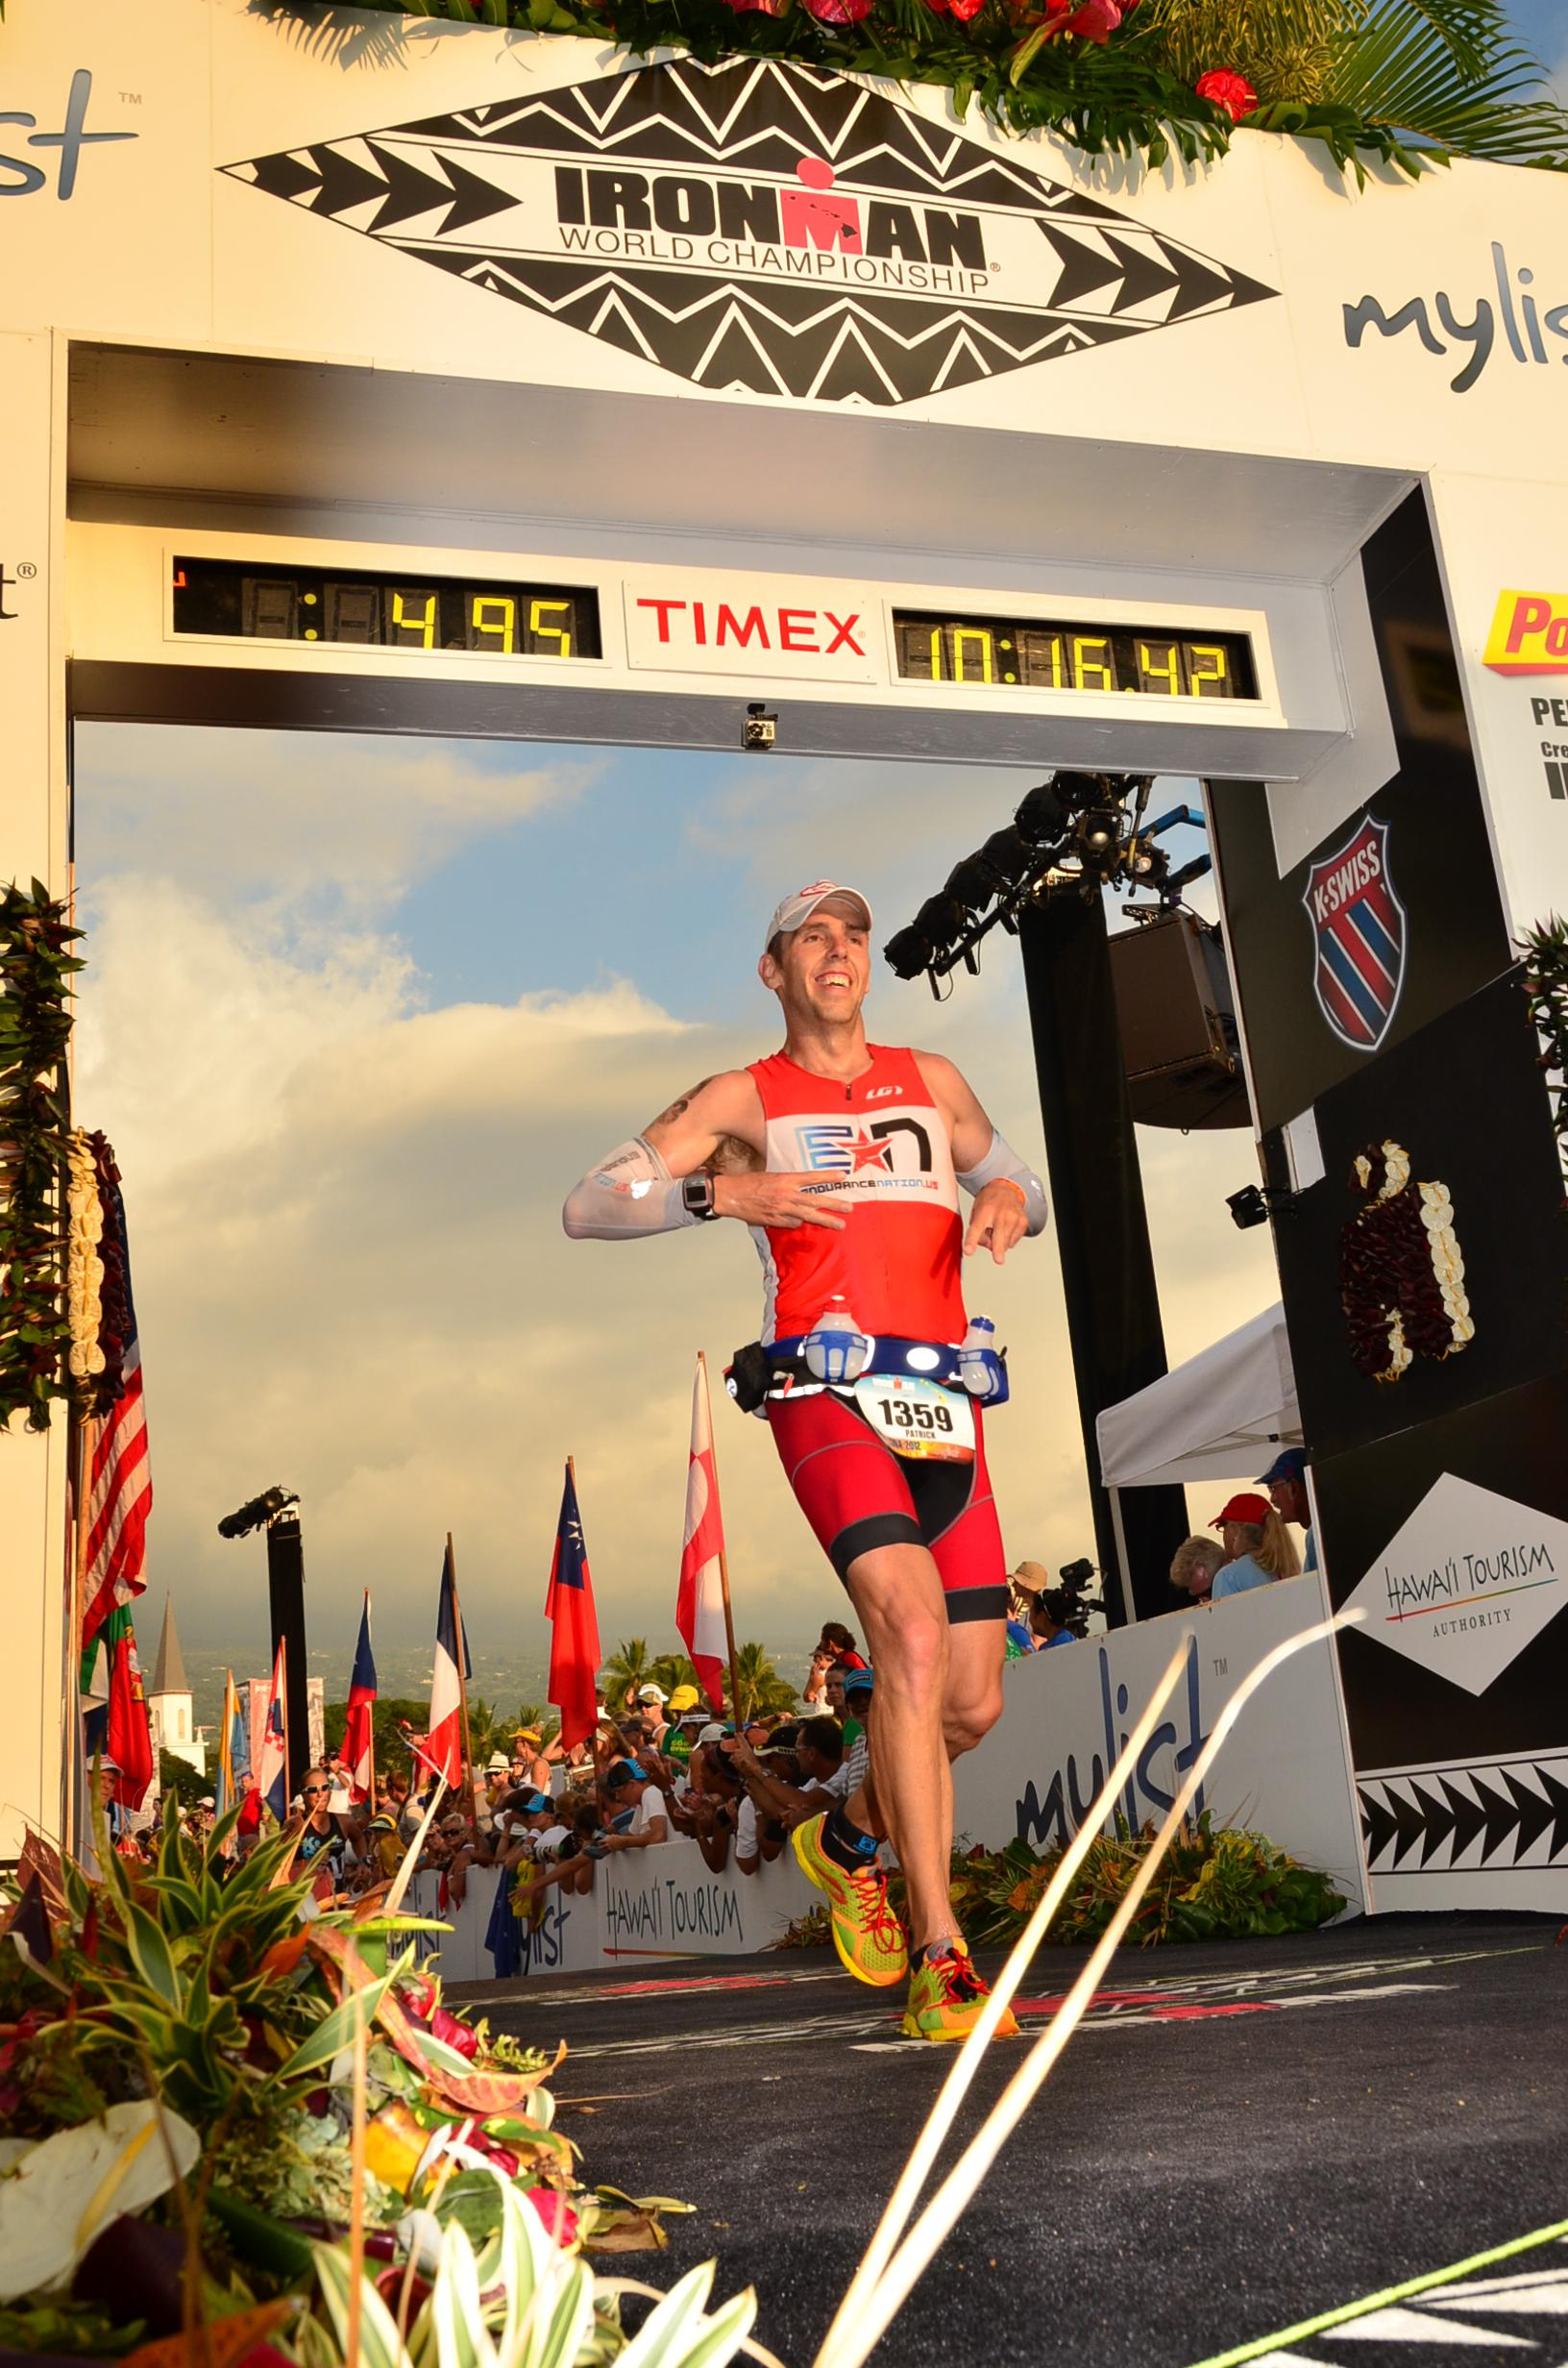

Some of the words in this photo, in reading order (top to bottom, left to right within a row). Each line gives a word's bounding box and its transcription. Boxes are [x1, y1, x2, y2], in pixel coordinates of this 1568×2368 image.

[554, 158, 987, 271] IRONMAN
[559, 227, 694, 260] WORLD
[707, 240, 989, 294] CHAMPIONSHIP
[636, 598, 866, 656] TIMEX
[1531, 698, 1568, 728] PE
[877, 1399, 954, 1432] 1359
[905, 1429, 937, 1440] PATRICK
[1463, 1543, 1555, 1591] TOURISM
[1433, 1608, 1511, 1638] AUTHORITY
[666, 1880, 744, 1943] TOURISM
